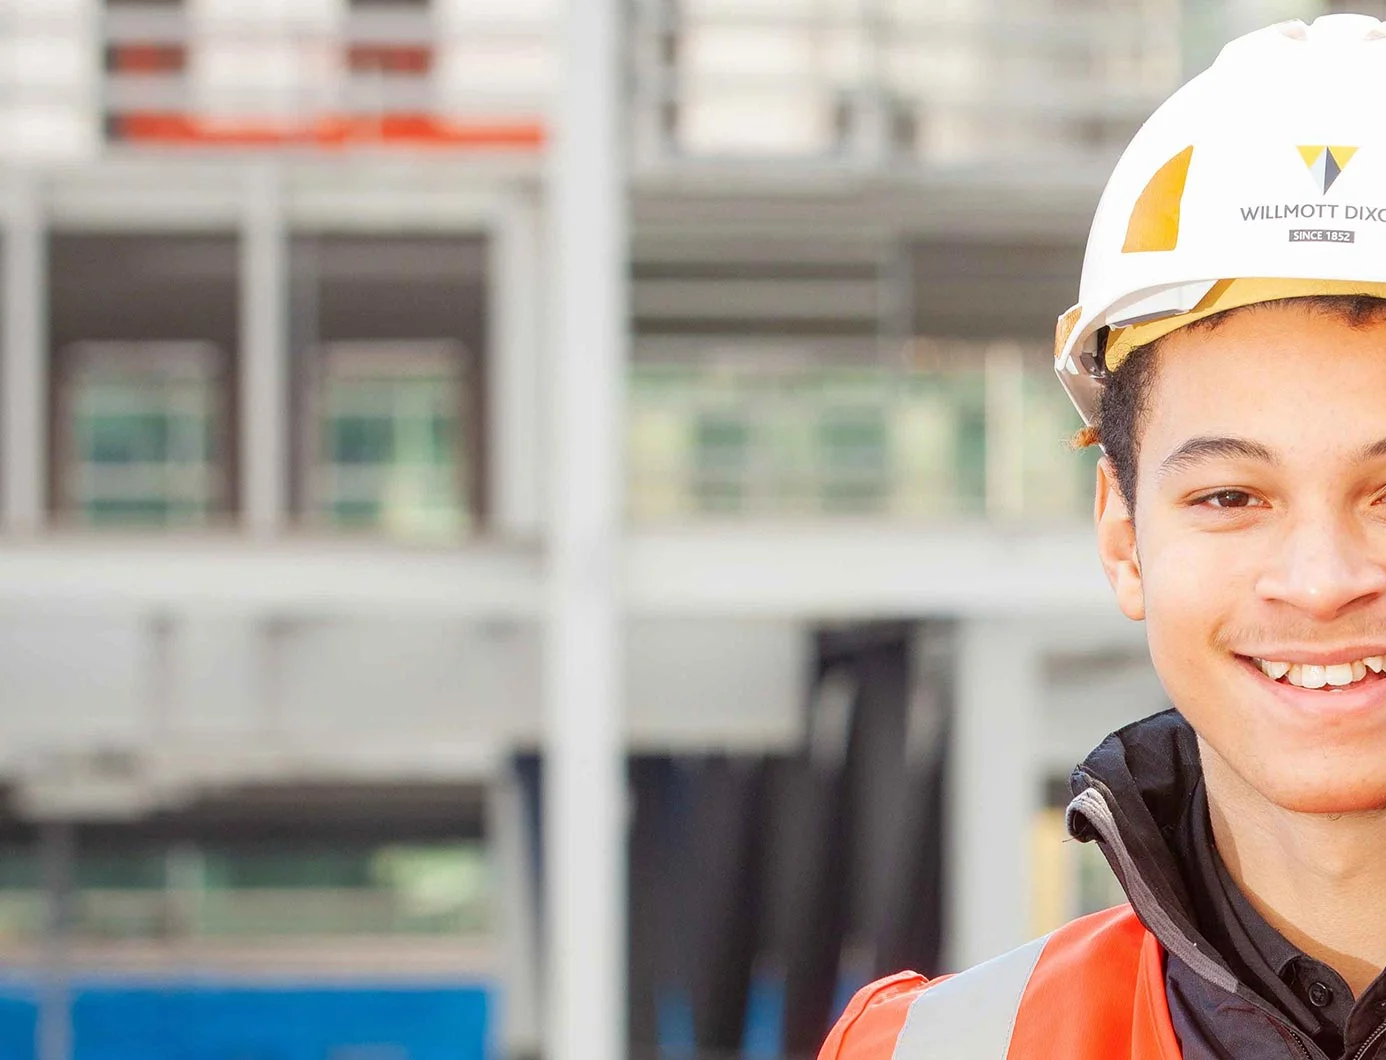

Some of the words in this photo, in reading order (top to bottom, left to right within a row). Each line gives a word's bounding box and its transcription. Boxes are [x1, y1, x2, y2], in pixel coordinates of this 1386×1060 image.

[1240, 204, 1339, 221] WILLMOTT
[1293, 231, 1323, 241] SINCE
[1325, 231, 1350, 242] 1852
